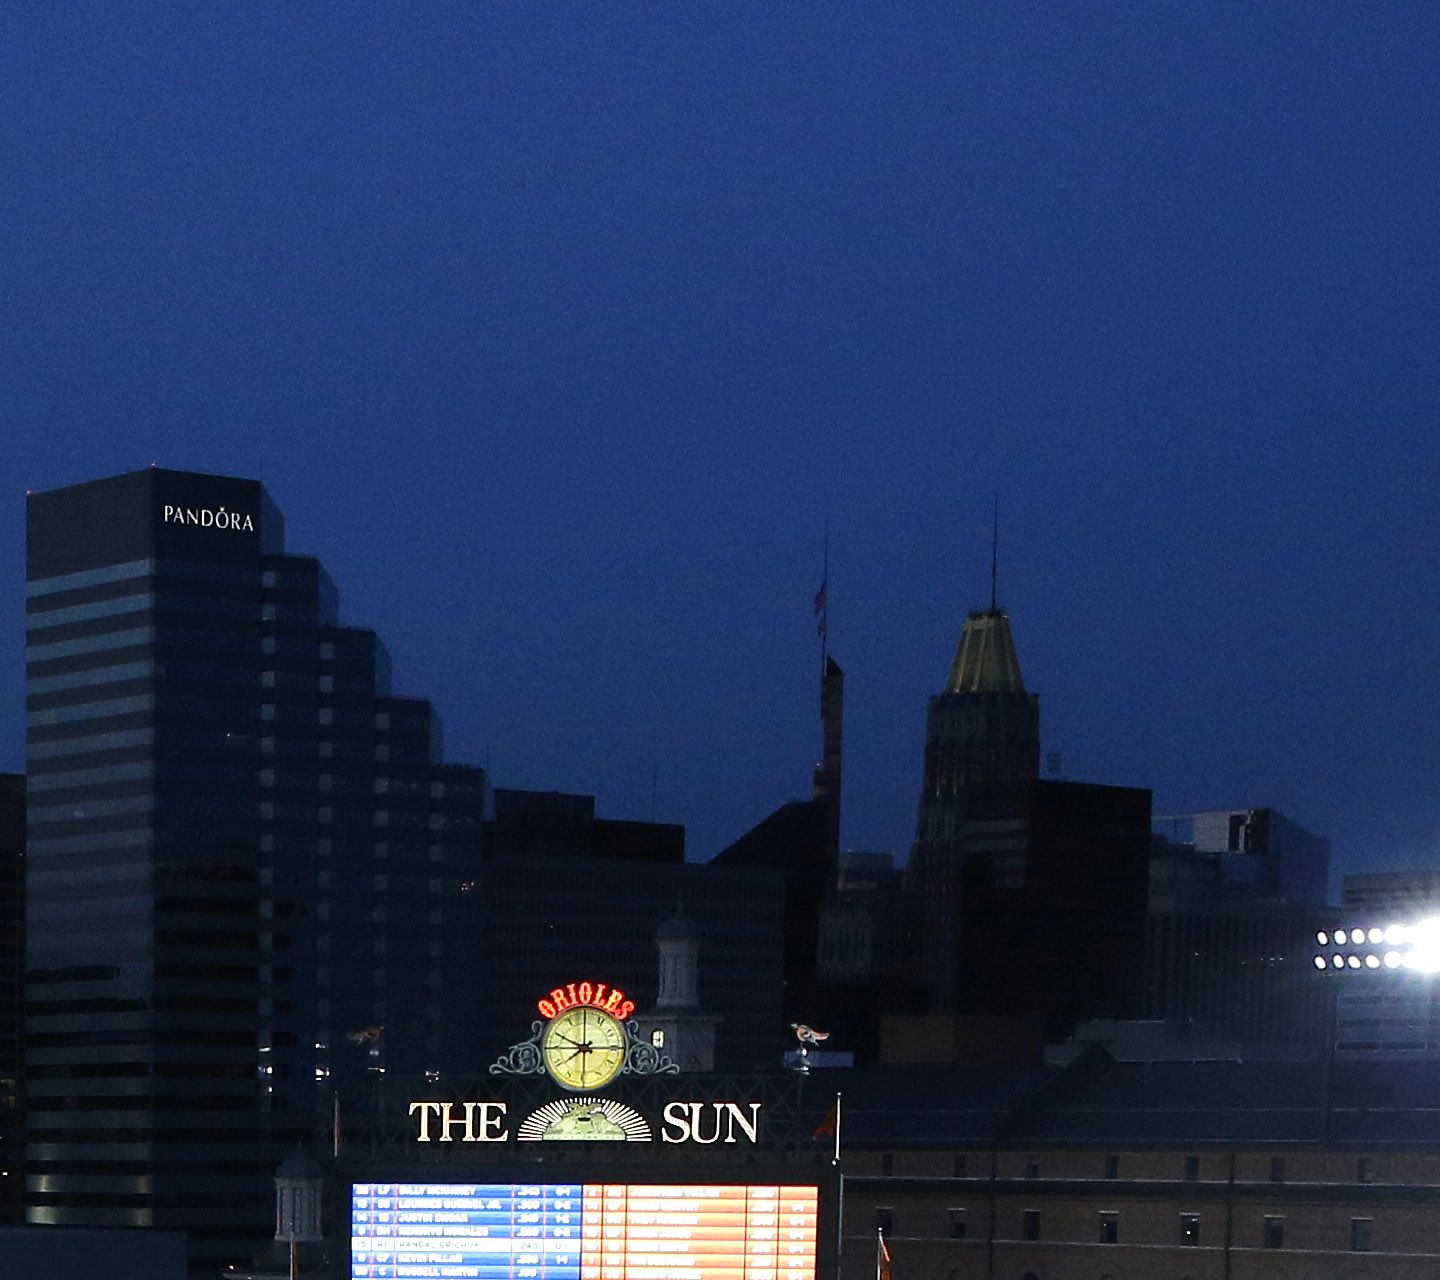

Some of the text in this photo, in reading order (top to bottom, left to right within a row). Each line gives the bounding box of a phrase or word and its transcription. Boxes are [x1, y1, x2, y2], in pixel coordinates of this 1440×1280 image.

[164, 505, 254, 532] PANDORA
[537, 981, 636, 1021] ORIOLES
[409, 1102, 762, 1144] THE SUN
